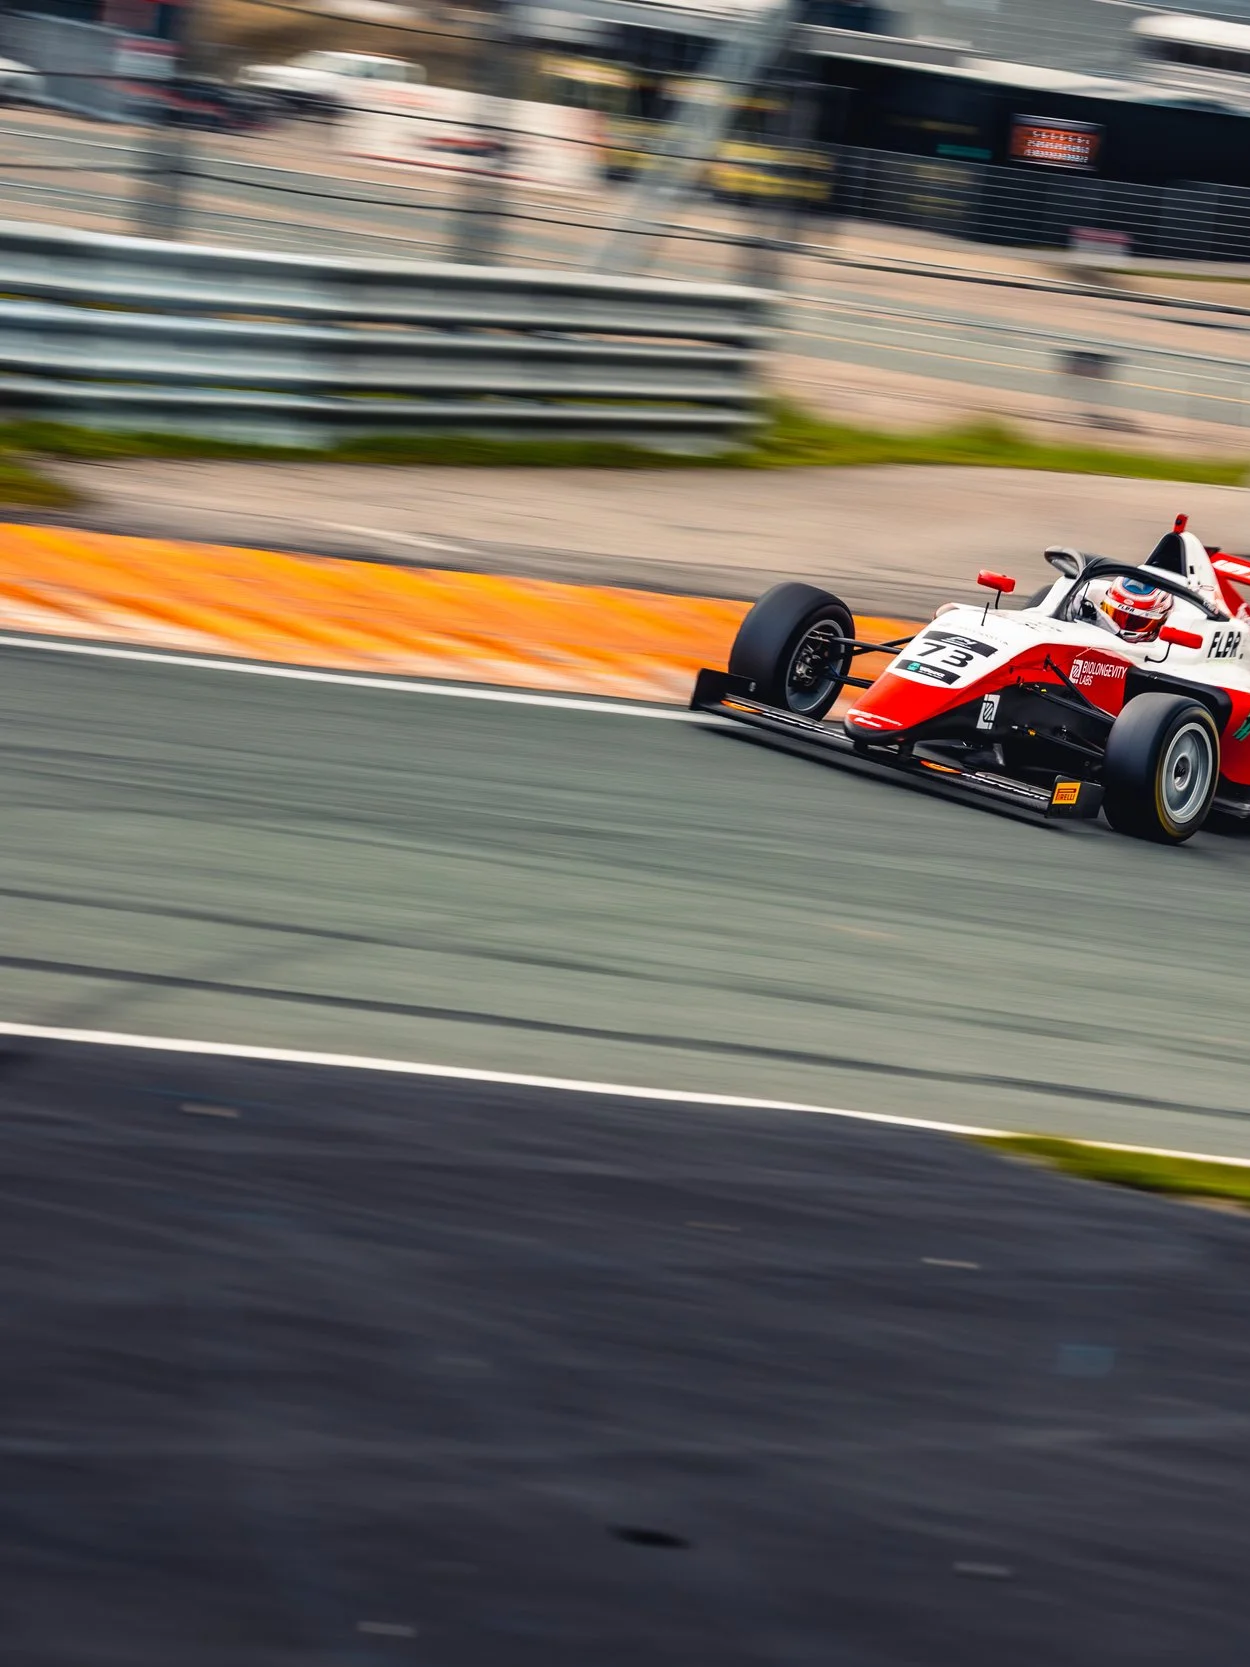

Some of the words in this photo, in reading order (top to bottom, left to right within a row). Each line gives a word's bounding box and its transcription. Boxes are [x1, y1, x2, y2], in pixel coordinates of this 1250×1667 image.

[917, 642, 974, 668] 73
[1081, 660, 1129, 679] BIOLONGEVITY
[1078, 674, 1094, 686] LABS
[1055, 788, 1077, 801] PIRELLI
